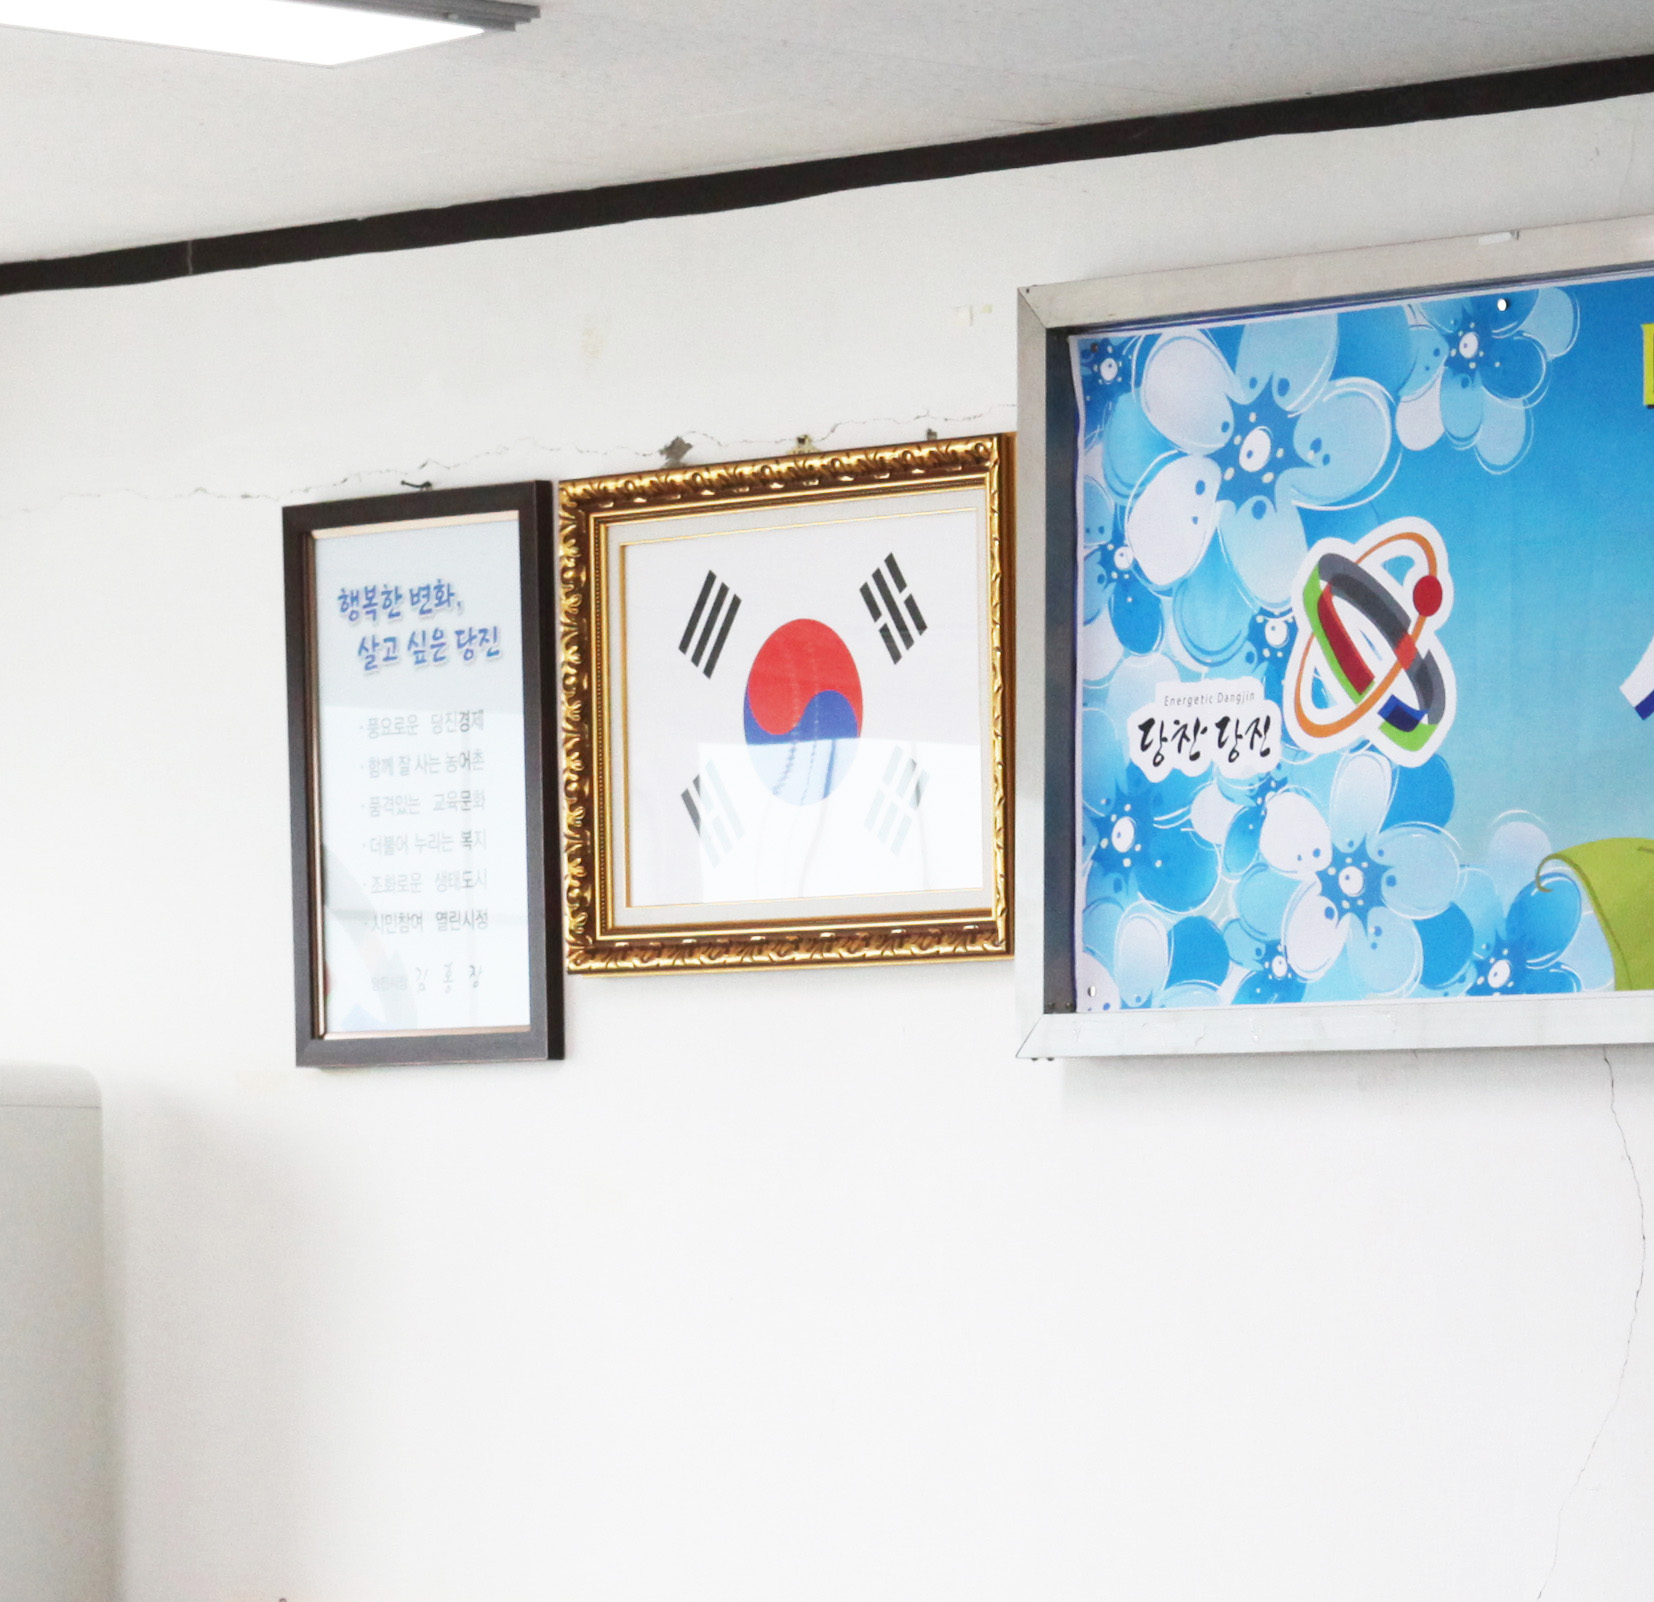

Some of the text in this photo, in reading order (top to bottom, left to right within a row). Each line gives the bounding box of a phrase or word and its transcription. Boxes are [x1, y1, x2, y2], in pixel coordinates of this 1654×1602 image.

[337, 584, 403, 622] 행복한
[358, 626, 500, 672] 살고 싶은 당진
[1164, 691, 1255, 708] Energetic Dangjin
[367, 708, 485, 740] 풍요로운 당진경제
[1138, 715, 1271, 768] 당찬 당진
[367, 755, 395, 779] 함께
[414, 753, 442, 775] 사는
[444, 748, 486, 774] 농어촌
[432, 789, 486, 813] 교육문화
[369, 829, 487, 857] 더불어 누리는 복지
[435, 867, 488, 893] 생태도시
[371, 907, 489, 934] 시민참여 열린시정
